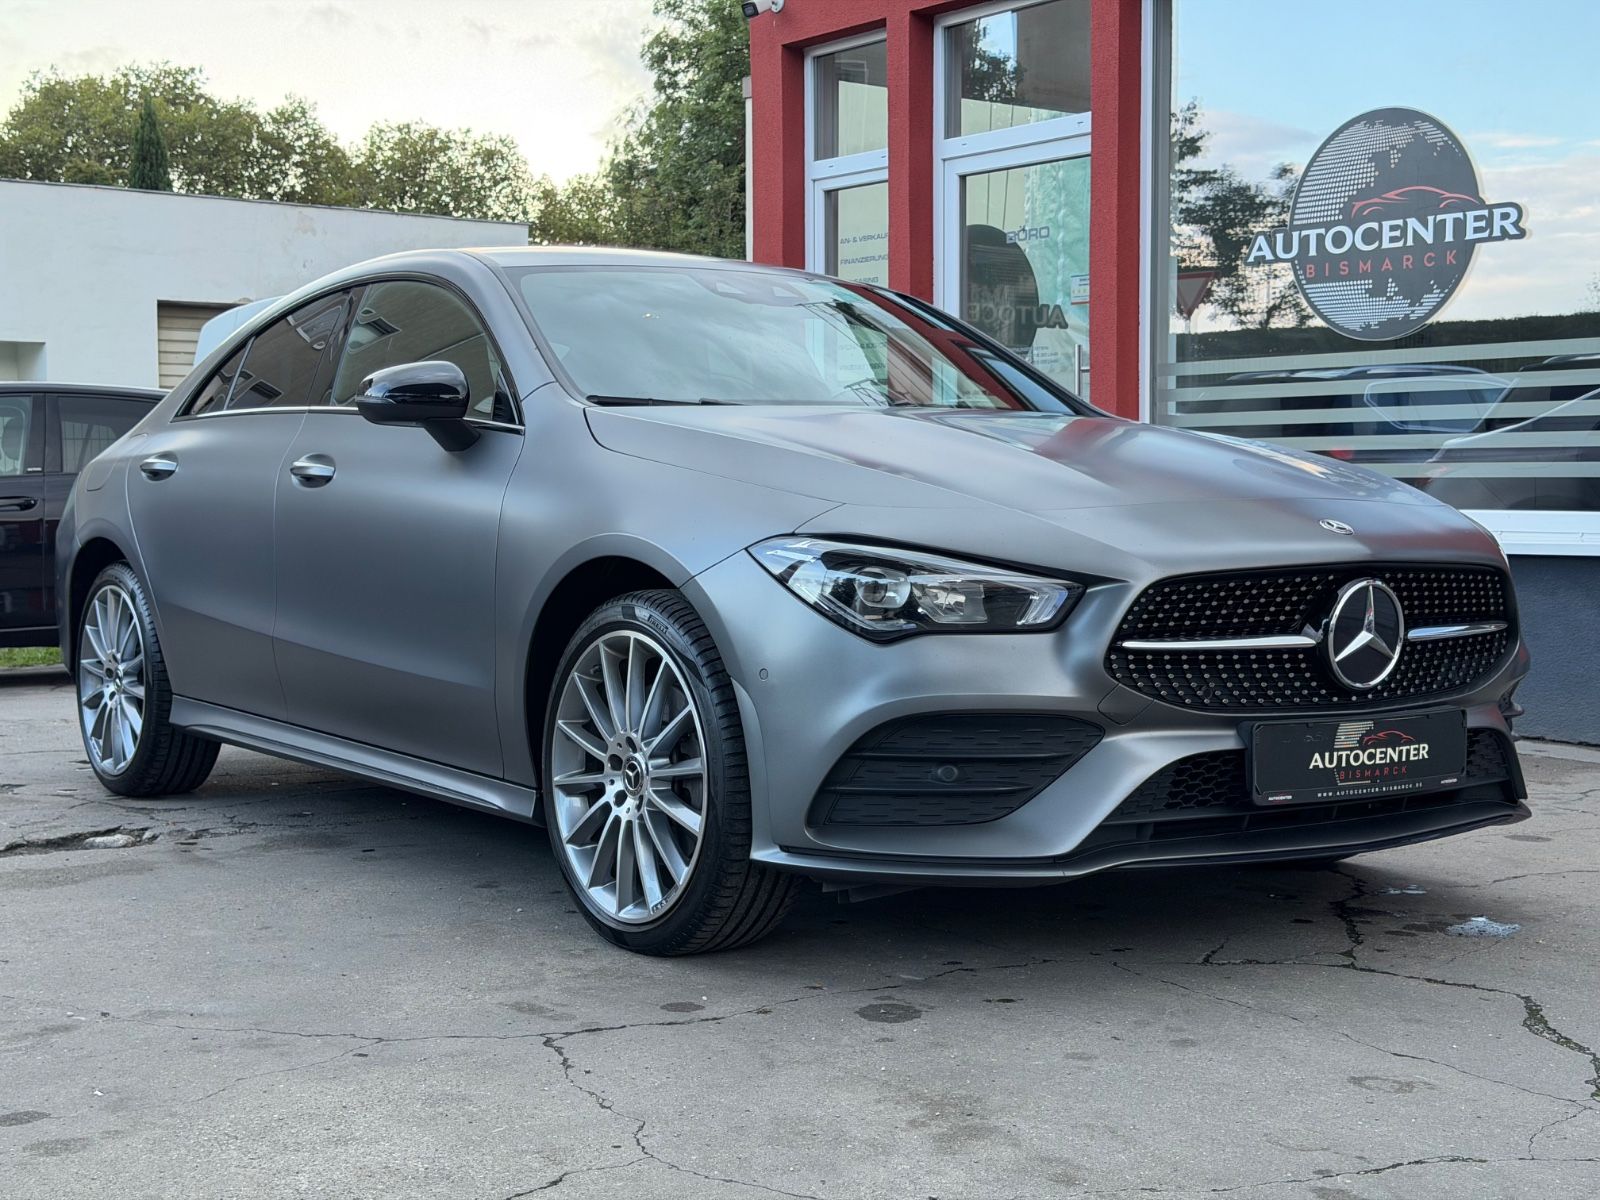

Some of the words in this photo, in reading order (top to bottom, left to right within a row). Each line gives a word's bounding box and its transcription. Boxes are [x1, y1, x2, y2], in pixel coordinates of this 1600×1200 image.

[1006, 226, 1050, 244] BÜRO
[1247, 206, 1521, 262] AUTOCENTER
[1305, 249, 1457, 278] BISMARCK
[1308, 743, 1429, 770] AUTOCENTER
[1339, 765, 1408, 781] BISMARCK
